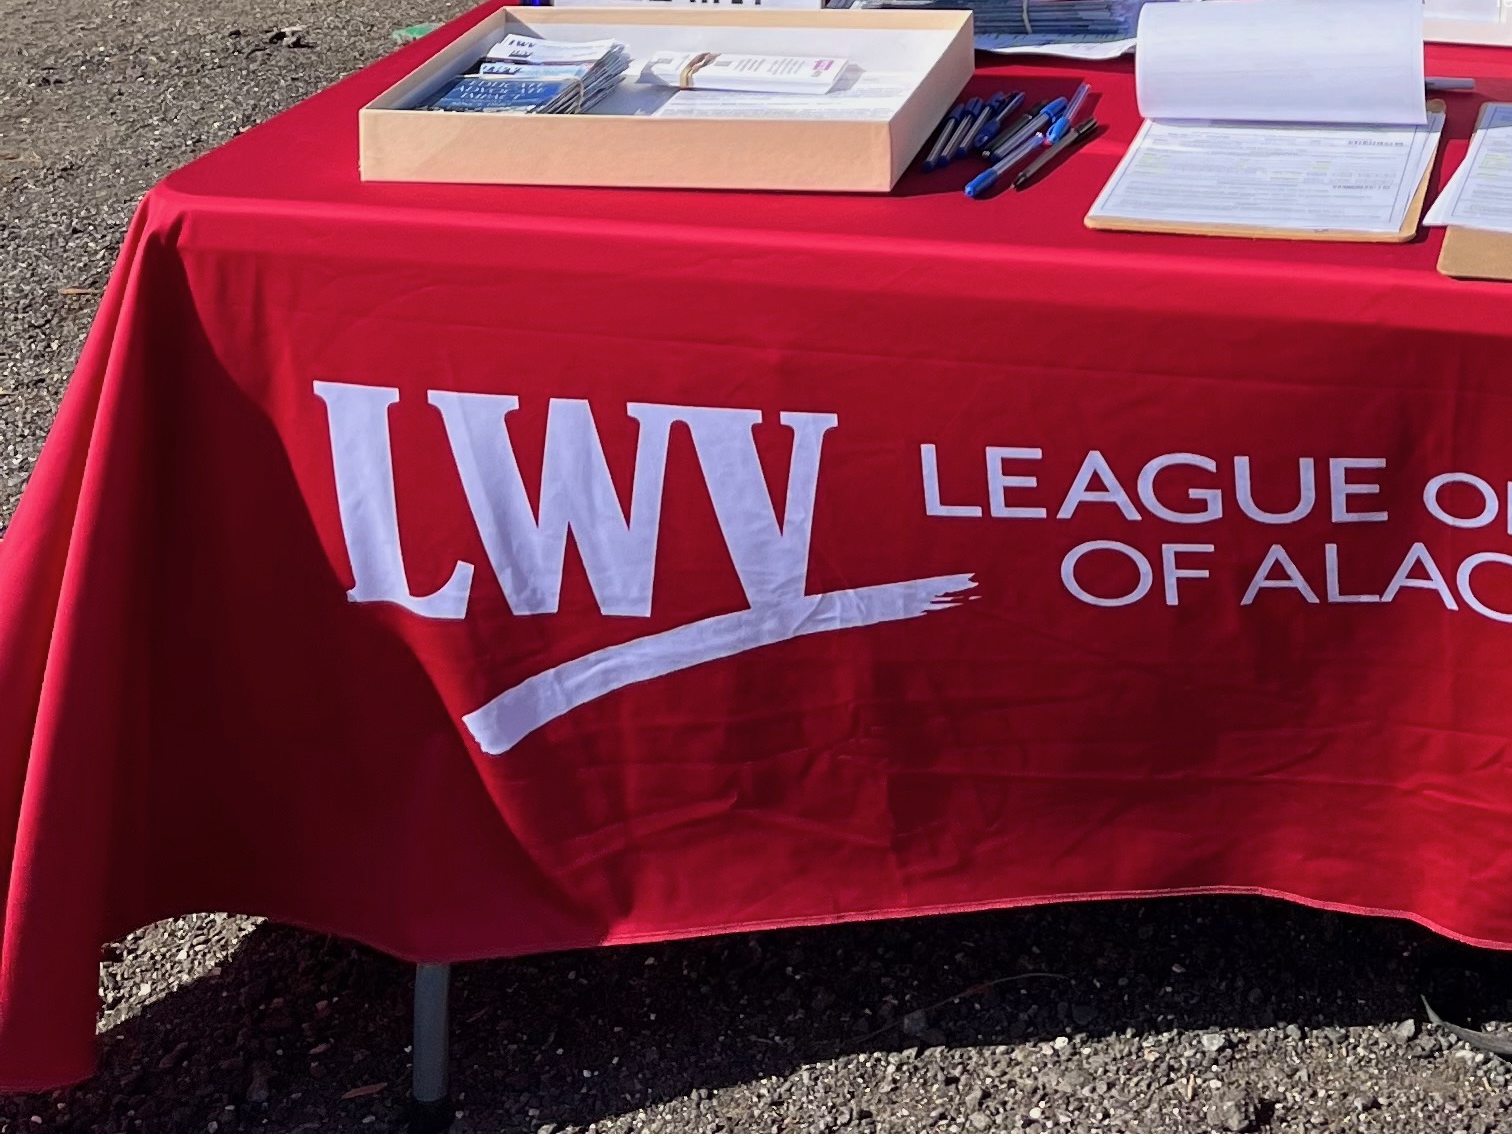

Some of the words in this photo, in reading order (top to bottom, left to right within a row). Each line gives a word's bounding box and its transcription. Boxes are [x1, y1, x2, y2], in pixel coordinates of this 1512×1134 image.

[313, 380, 838, 622] LWV
[920, 443, 1388, 524] LEAGUE
[1060, 539, 1214, 607] OF
